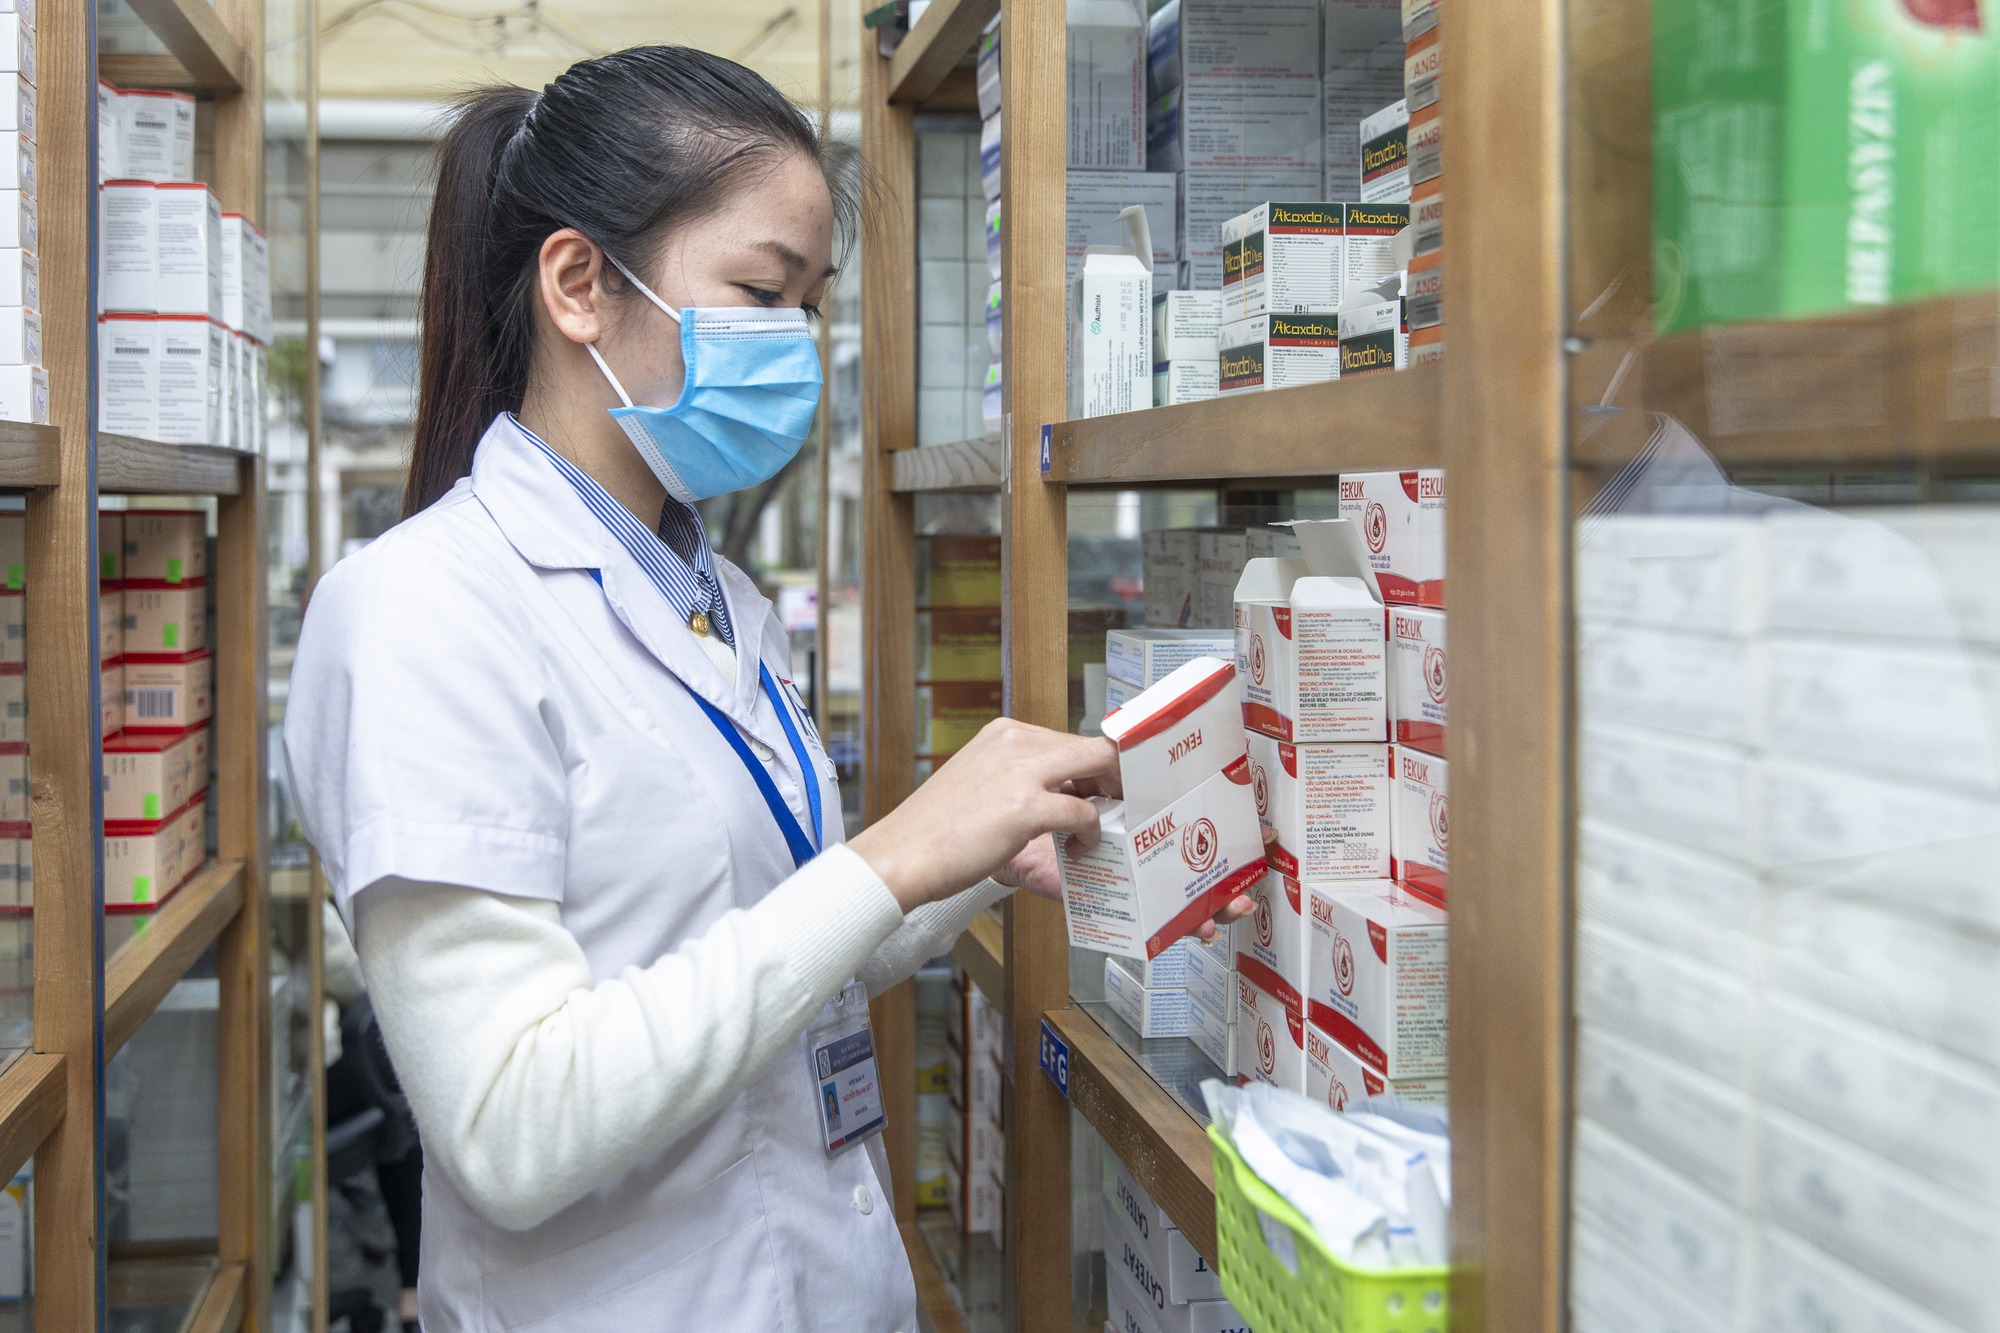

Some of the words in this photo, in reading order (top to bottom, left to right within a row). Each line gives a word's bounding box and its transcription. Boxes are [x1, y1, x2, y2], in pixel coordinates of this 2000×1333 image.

[1363, 140, 1397, 173] Akoxdo
[1272, 208, 1323, 223] Akoxdo
[1324, 215, 1340, 224] Plus
[1348, 209, 1399, 225] Akoxdo
[1400, 214, 1410, 225] Plu
[1224, 247, 1252, 275] Akoxdo
[1252, 249, 1262, 264] Plus
[1272, 320, 1323, 336] Akoxdo
[1323, 326, 1339, 336] Plus
[1139, 351, 1145, 359] TY
[1220, 355, 1250, 380] Akoxdo
[1250, 359, 1262, 374] Plus
[1341, 343, 1377, 370] Akoxdo
[1377, 349, 1393, 365] Plus
[1043, 437, 1050, 464] A
[1341, 481, 1365, 499] FEKUK
[1396, 616, 1423, 639] FEKUK
[1168, 729, 1203, 766] FEKUK
[1403, 757, 1429, 783] FEKUK
[1134, 812, 1176, 854] FEKUK
[1137, 853, 1151, 868] Dung
[1151, 845, 1162, 860] dịch
[1198, 842, 1207, 854] Fe
[1311, 894, 1333, 924] FEKUK
[1239, 980, 1258, 1009] FEKUK
[1042, 1034, 1048, 1064] E
[1050, 1043, 1056, 1072] F
[1057, 1053, 1067, 1085] G
[1308, 1031, 1330, 1067] FEKUK
[1117, 1176, 1148, 1240] CATEFAT
[1123, 1243, 1164, 1310] CATEFAT
